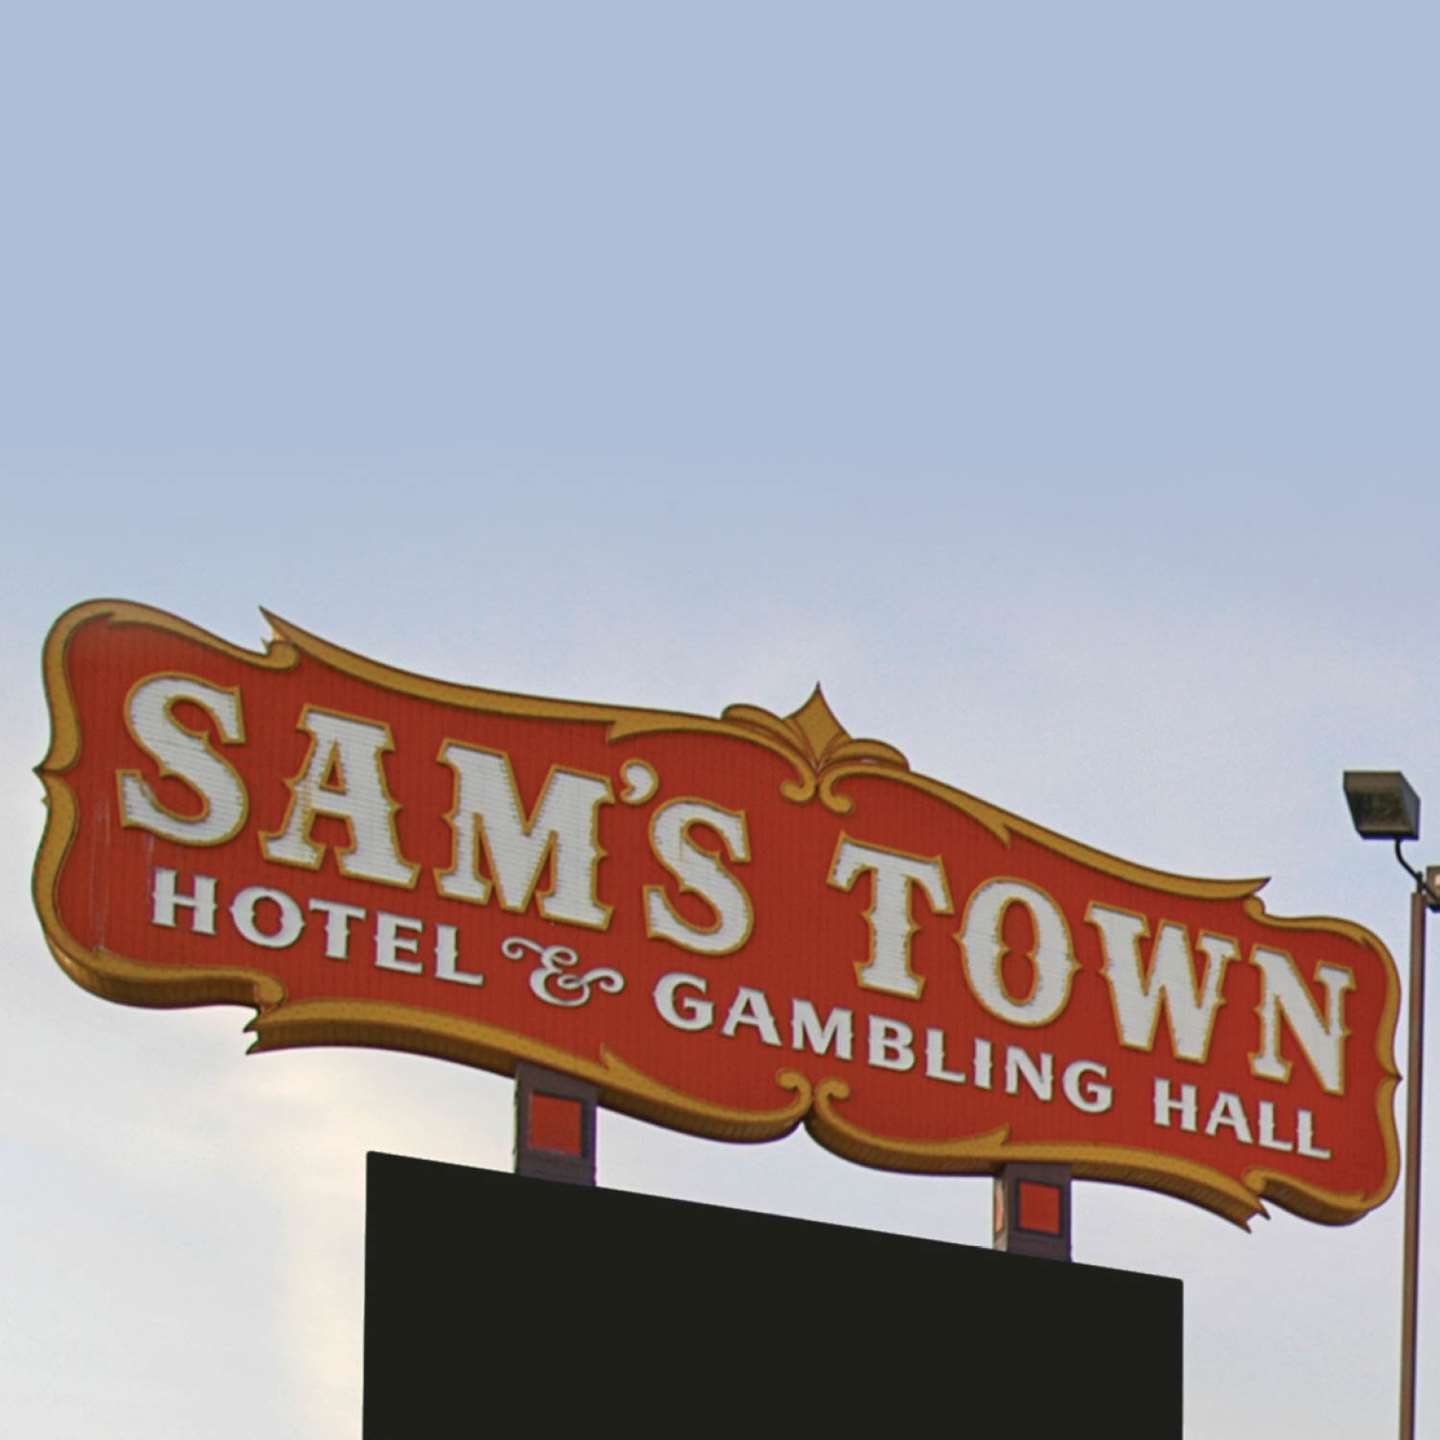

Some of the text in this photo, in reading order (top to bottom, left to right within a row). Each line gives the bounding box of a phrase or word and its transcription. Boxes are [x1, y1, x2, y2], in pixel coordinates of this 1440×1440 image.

[115, 671, 1356, 1095] SAM'S TOWN
[151, 867, 1332, 1160] HOTEL & GAMBLING HALL
